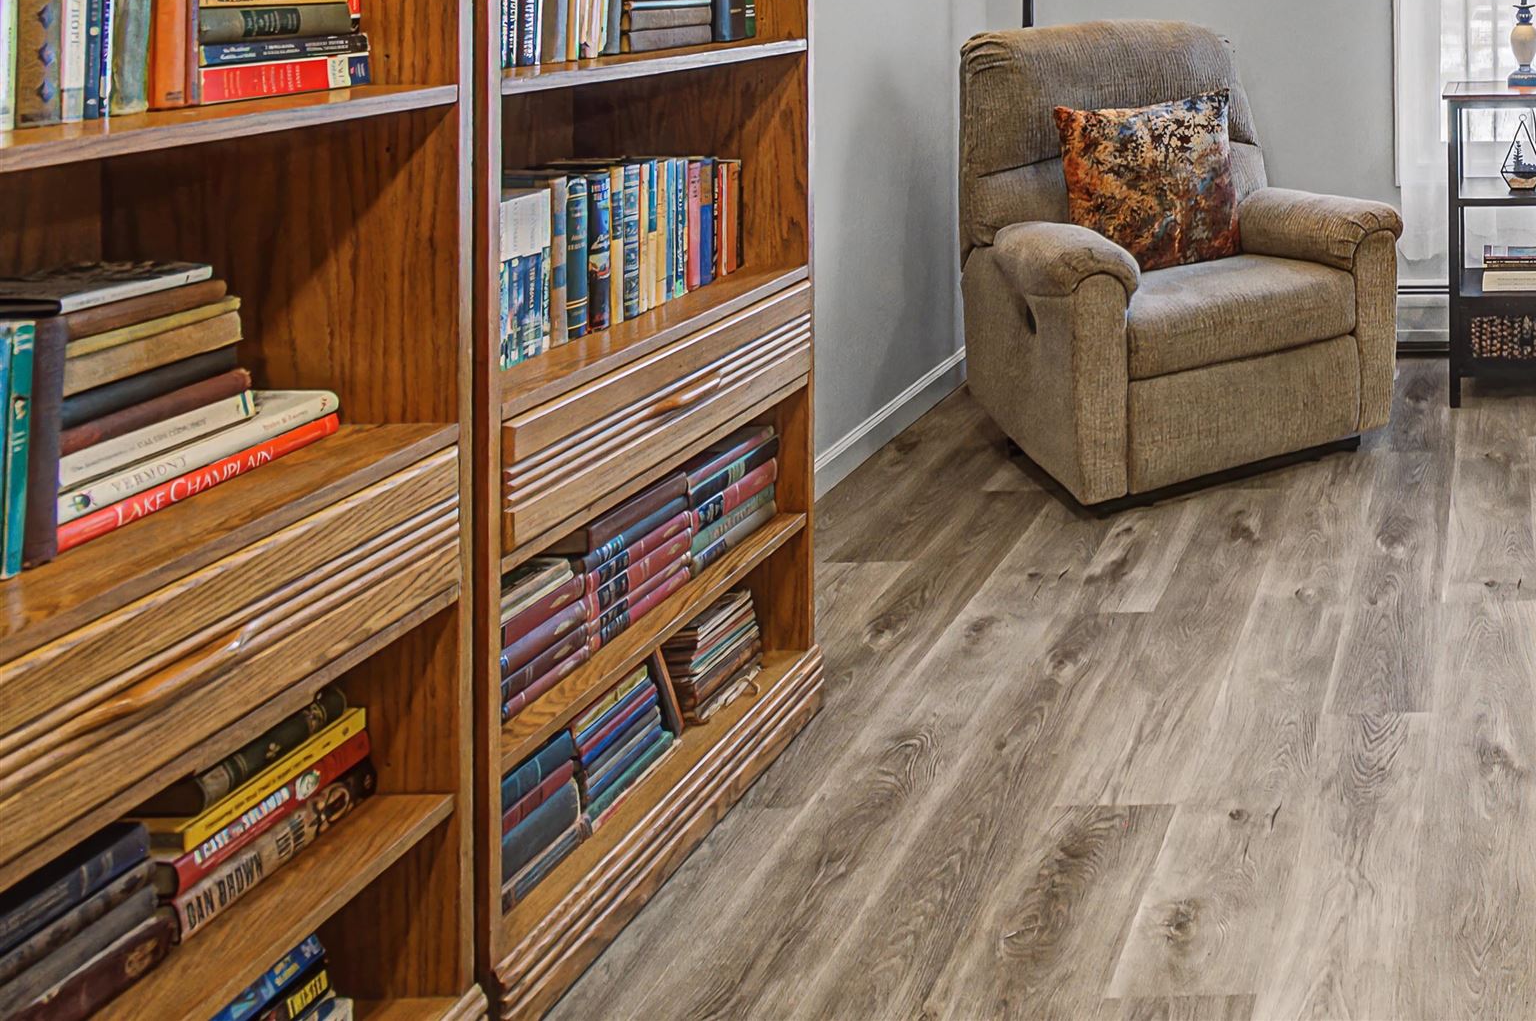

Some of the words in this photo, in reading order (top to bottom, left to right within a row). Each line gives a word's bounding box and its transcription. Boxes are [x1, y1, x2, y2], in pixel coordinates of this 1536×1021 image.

[110, 455, 188, 493] VERMONT
[114, 492, 168, 526] LAKE
[170, 447, 275, 502] CHAMPLAIN
[185, 886, 216, 930] DAN
[217, 851, 264, 906] BROWN
